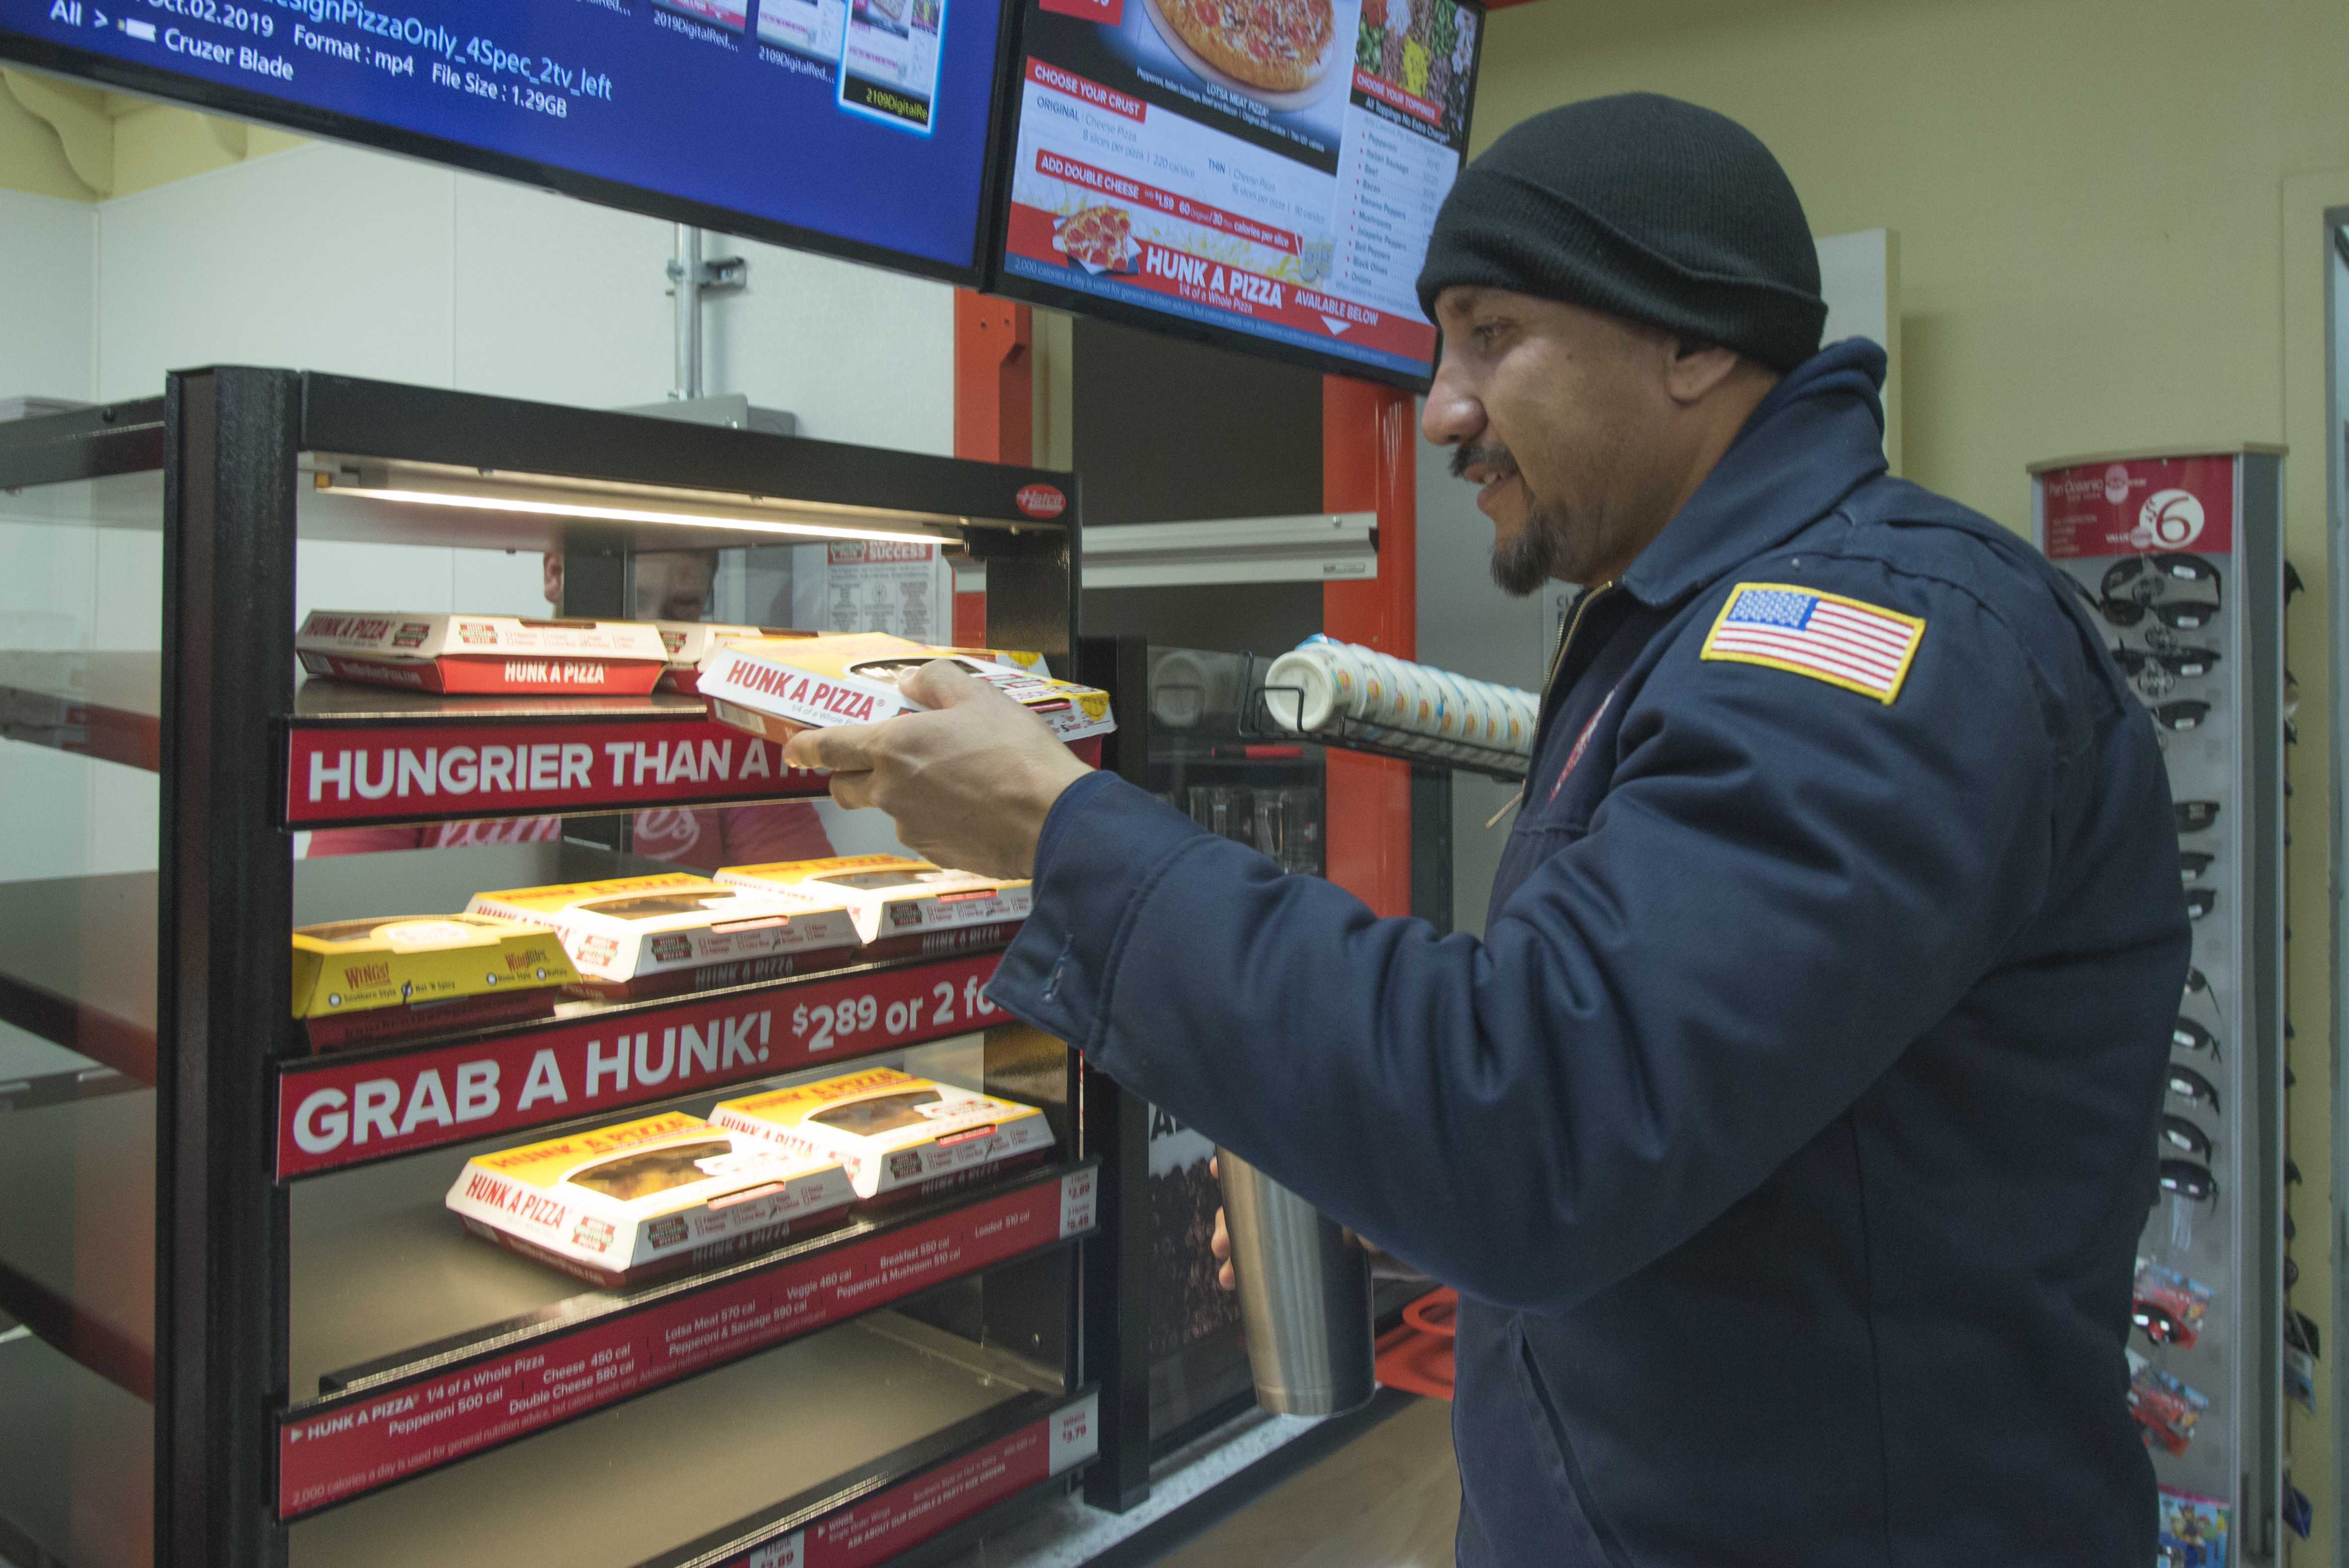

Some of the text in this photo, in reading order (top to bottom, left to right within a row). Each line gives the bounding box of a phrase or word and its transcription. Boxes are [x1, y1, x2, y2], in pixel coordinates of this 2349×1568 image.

[50, 0, 81, 26] All
[164, 27, 294, 81] Cruzer Blade
[294, 23, 415, 76] Format mp4
[431, 61, 568, 118] File Size 1.29GB
[1035, 64, 1077, 93] CHOOSE
[1080, 81, 1107, 105] YOUR
[1109, 91, 1140, 118] CRUST
[1037, 95, 1080, 122] ORIGINAL
[1041, 154, 1063, 174] ADD
[1065, 162, 1103, 187] DOUBLE
[1105, 176, 1140, 200] CHEESE
[1146, 245, 1208, 289] HUNK
[1211, 265, 1225, 294] A
[1191, 287, 1201, 300] of
[1201, 291, 1207, 302] a
[1209, 290, 1232, 308] Whole
[1234, 298, 1253, 314] Pizza
[1295, 290, 1346, 317] AVAILABLE
[1347, 303, 1379, 327] BELOW
[869, 546, 927, 560] SUCCESS
[504, 660, 605, 684] HUNK A PIZZA
[726, 659, 796, 698] HUNK
[789, 678, 810, 703] A
[803, 708, 812, 717] of
[819, 712, 843, 725] Whole
[309, 743, 593, 802] HUNGRIER
[605, 738, 732, 787] THAN
[738, 738, 769, 780] A
[293, 1058, 501, 1154] GRAB
[517, 1048, 568, 1112] A
[586, 1010, 772, 1098] HUNK!
[792, 994, 877, 1053] $289
[885, 996, 923, 1035] or
[933, 981, 954, 1026] 2
[963, 975, 1006, 1019] fo
[465, 1172, 566, 1230] HUNK A PIZZA
[975, 1218, 1002, 1239] Loaded
[1020, 1209, 1030, 1225] cal
[837, 1273, 880, 1300] Pepperoni
[882, 1270, 888, 1285] &
[890, 1259, 932, 1282] Mushroom
[950, 1247, 961, 1262] cal
[880, 1236, 950, 1269] Breakfast cal
[787, 1279, 818, 1300] Veggie
[839, 1267, 852, 1283] cal
[666, 1299, 755, 1342] Lotsa Meat 570 cal
[669, 1299, 807, 1357] Pepperoni & Sausage cal
[509, 1389, 550, 1416] Double
[553, 1375, 594, 1399] Cheese
[619, 1356, 634, 1375] cal
[543, 1341, 630, 1384] Cheese 450 cal
[308, 1413, 355, 1441] HUNK
[357, 1409, 369, 1427] A
[427, 1383, 445, 1403] 1/4
[447, 1380, 461, 1397] of
[463, 1379, 471, 1392] a
[474, 1365, 511, 1388] Whole
[515, 1354, 545, 1375] Pizza
[389, 1385, 503, 1438] Pepperoni 500 cal
[327, 1471, 367, 1495] calories
[377, 1463, 396, 1477] day
[408, 1449, 431, 1468] used
[433, 1444, 445, 1460] for
